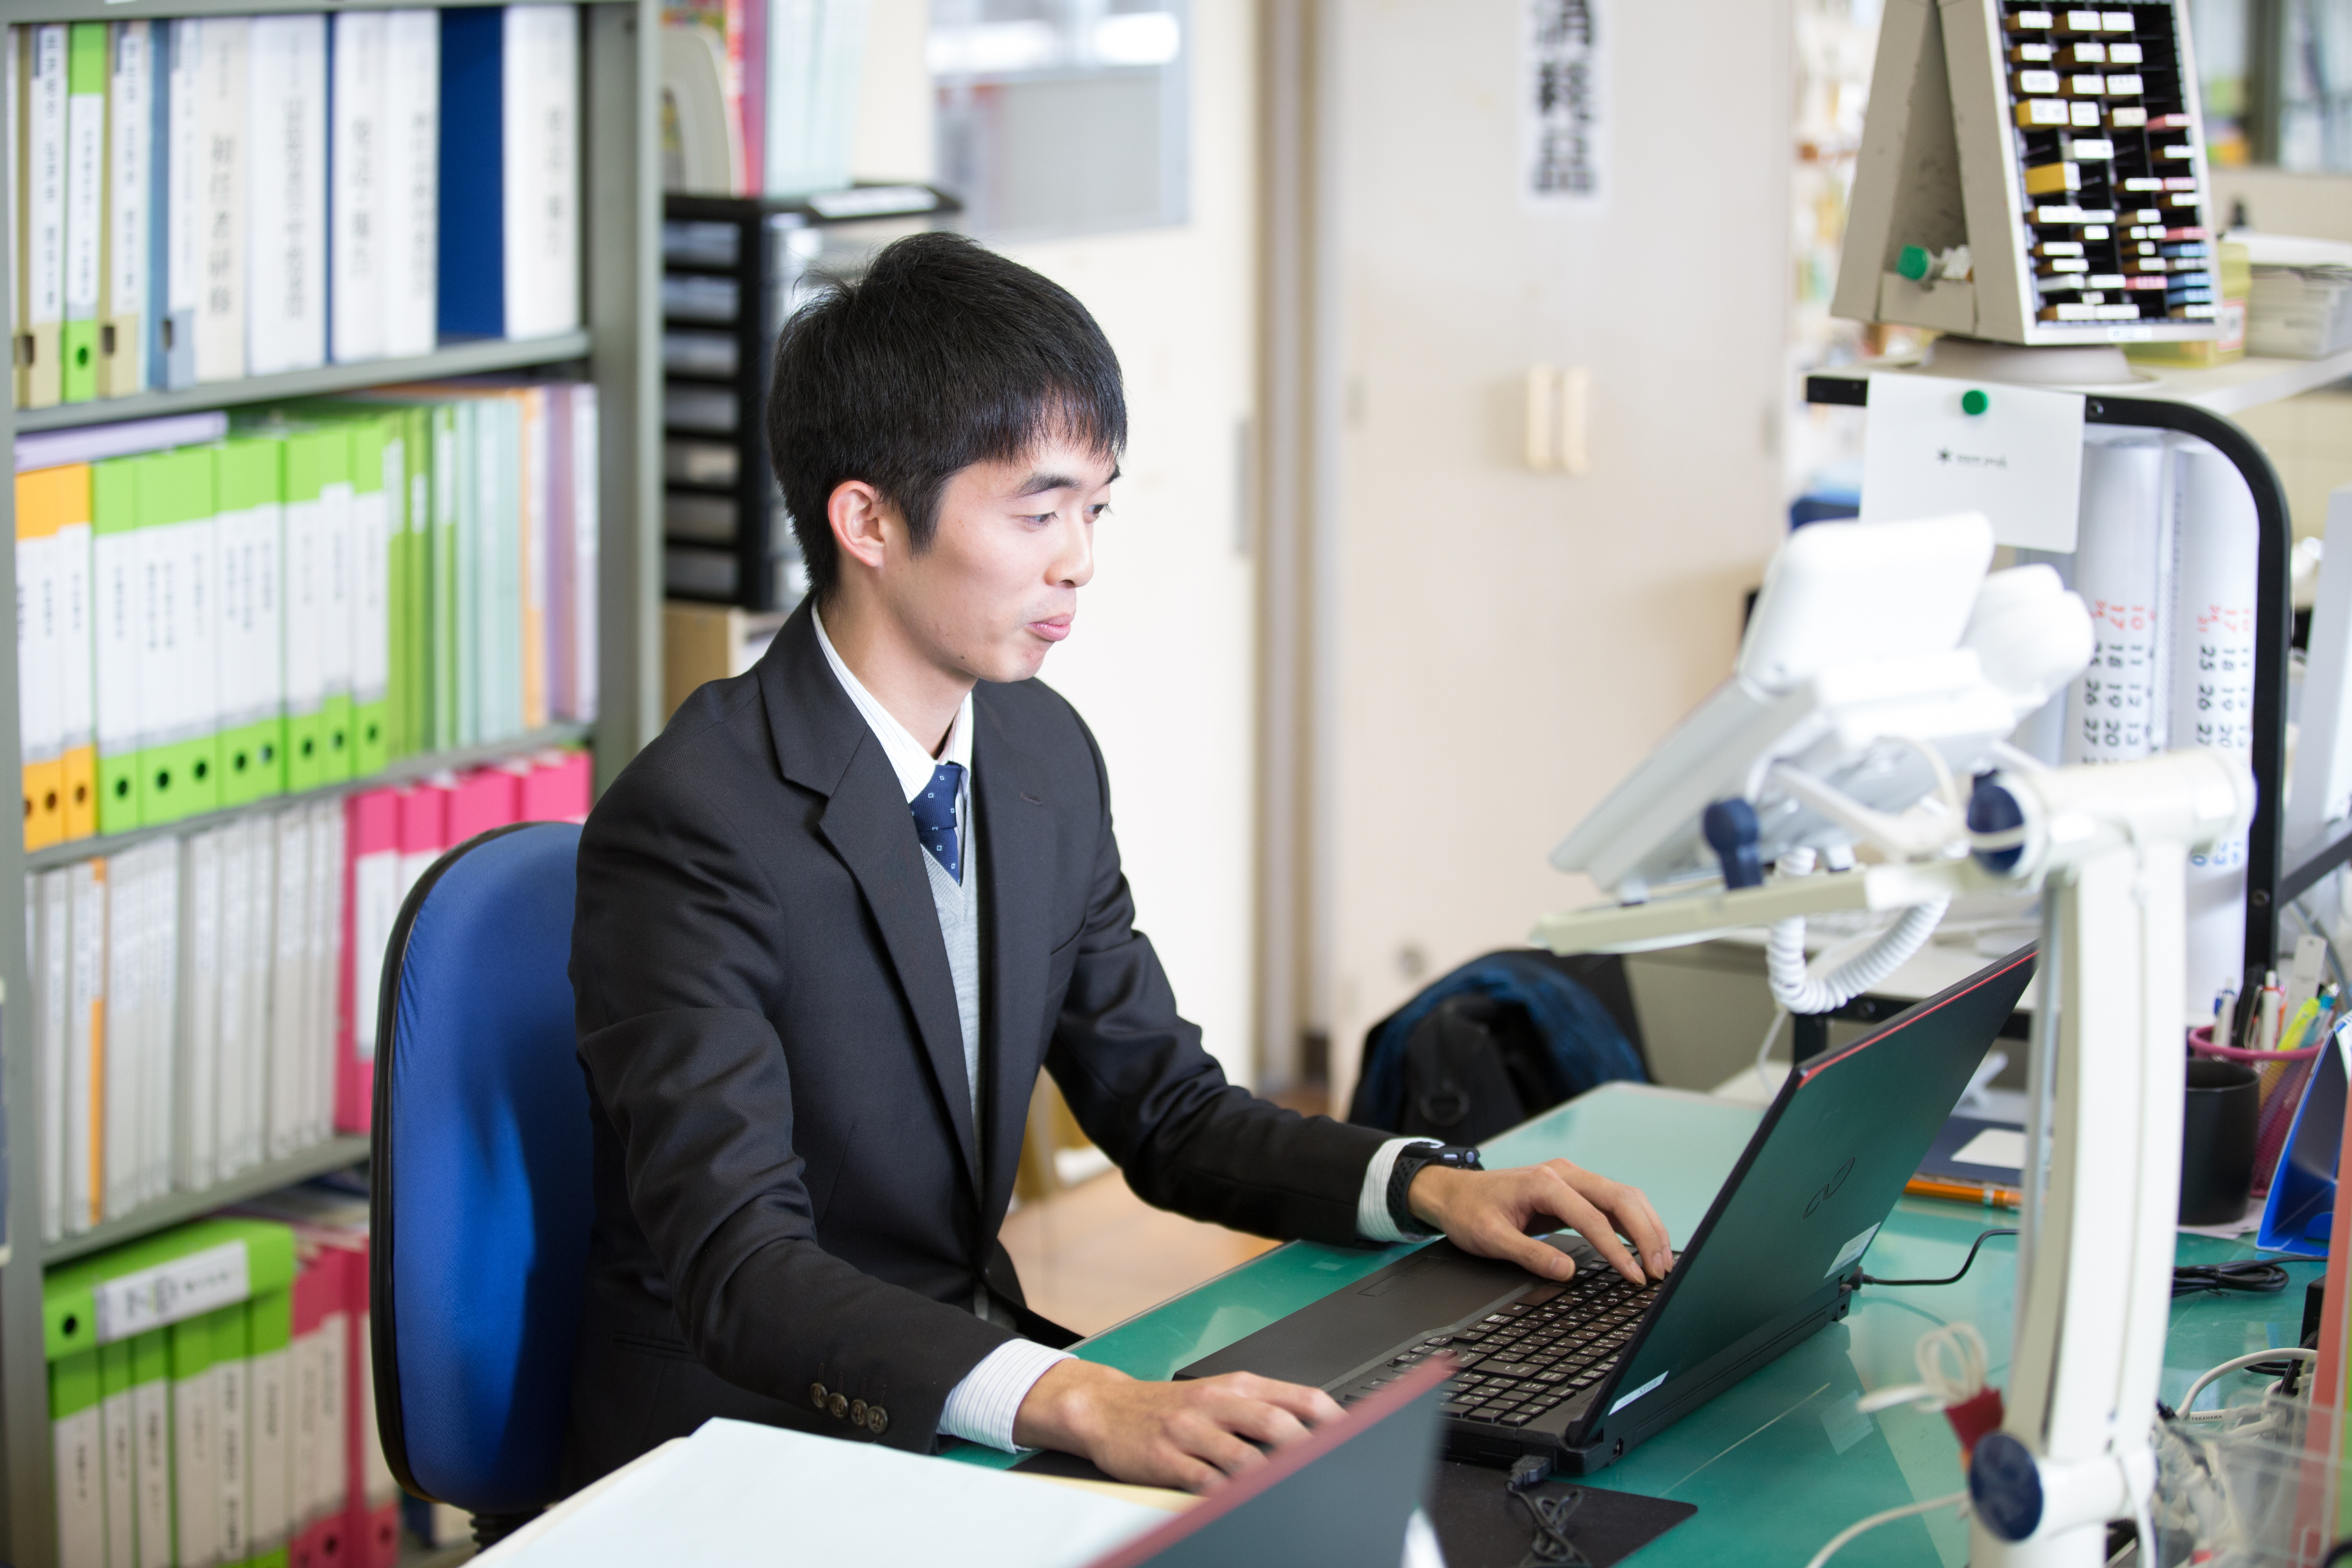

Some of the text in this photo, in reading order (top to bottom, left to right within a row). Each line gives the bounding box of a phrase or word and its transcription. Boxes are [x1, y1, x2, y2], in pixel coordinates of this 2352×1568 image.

[2131, 606, 2145, 630] 10
[2200, 644, 2216, 671] 25
[2105, 606, 2125, 747] 17 18 19 20
[2219, 610, 2237, 748] 17 18 19 20
[2086, 678, 2100, 706] 26
[2198, 684, 2214, 710] 26
[2084, 717, 2098, 746] 27
